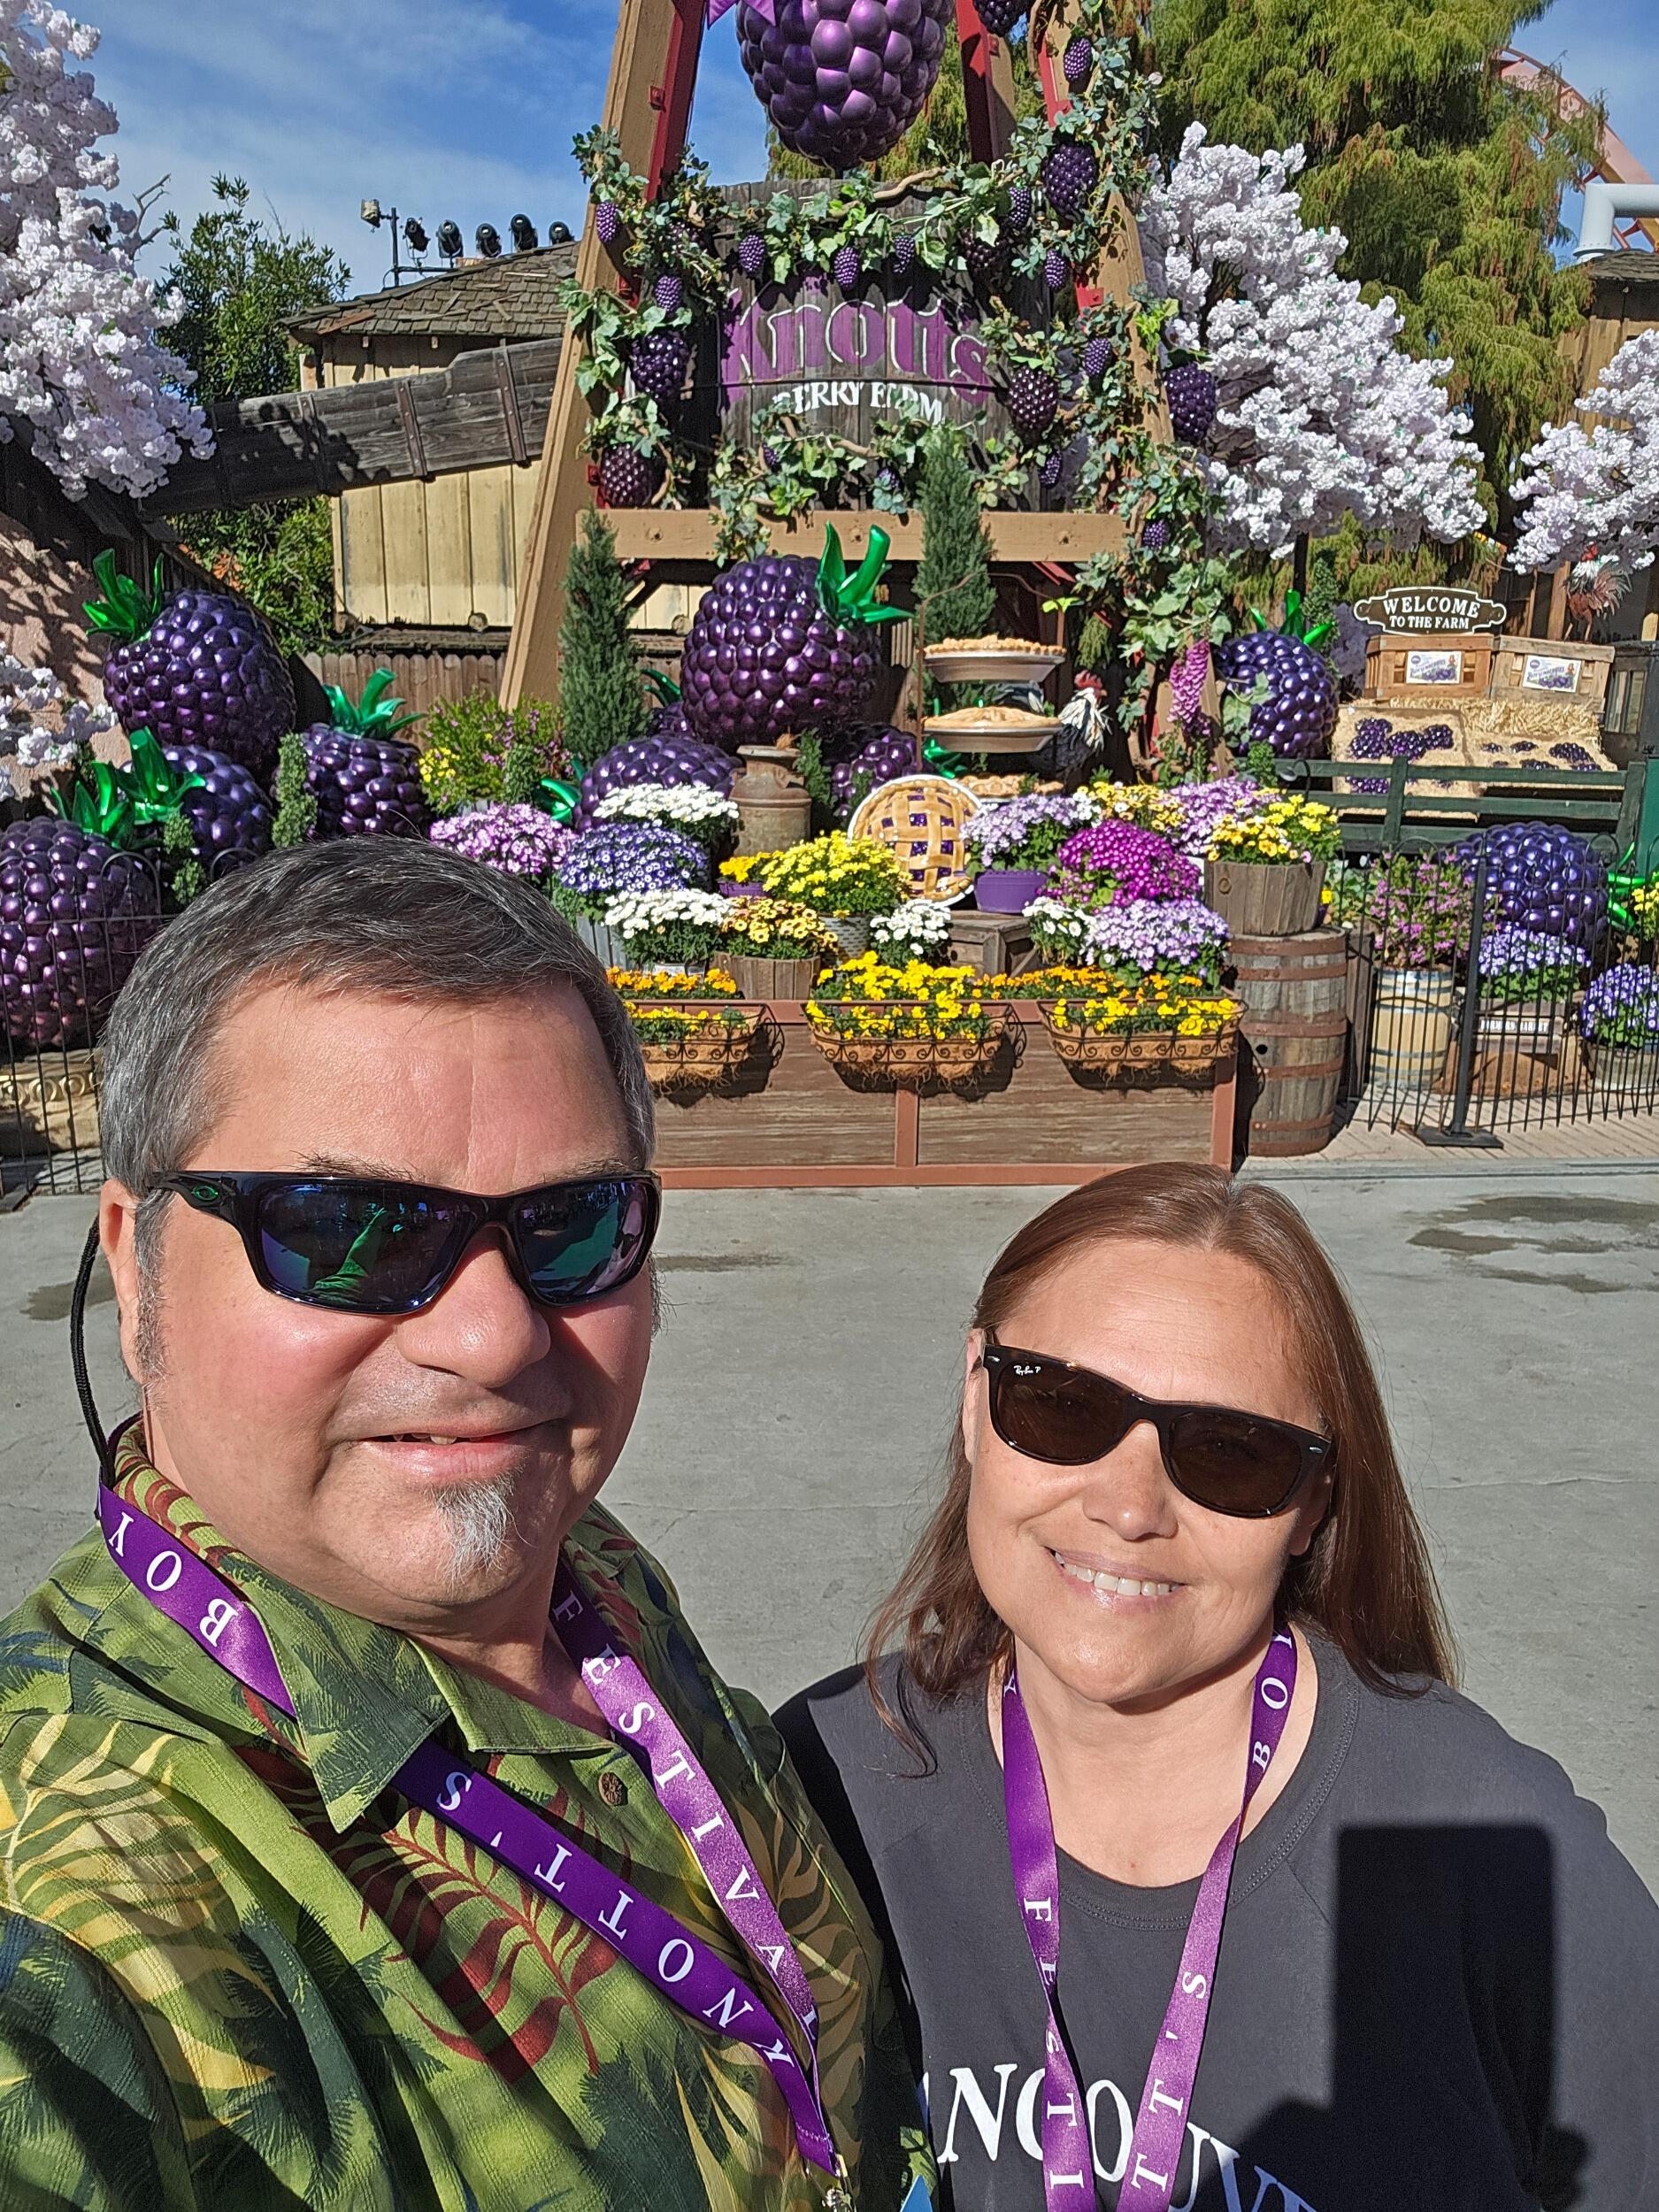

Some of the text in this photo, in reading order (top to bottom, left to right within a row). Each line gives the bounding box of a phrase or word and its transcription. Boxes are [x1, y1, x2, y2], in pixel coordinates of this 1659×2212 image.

[870, 381, 943, 426] FRM
[1382, 595, 1480, 618] WELCOME
[1389, 615, 1470, 630] TO THE FARM
[552, 1590, 819, 2041] FESTIVAL
[436, 1770, 796, 2069] KNOTT'S
